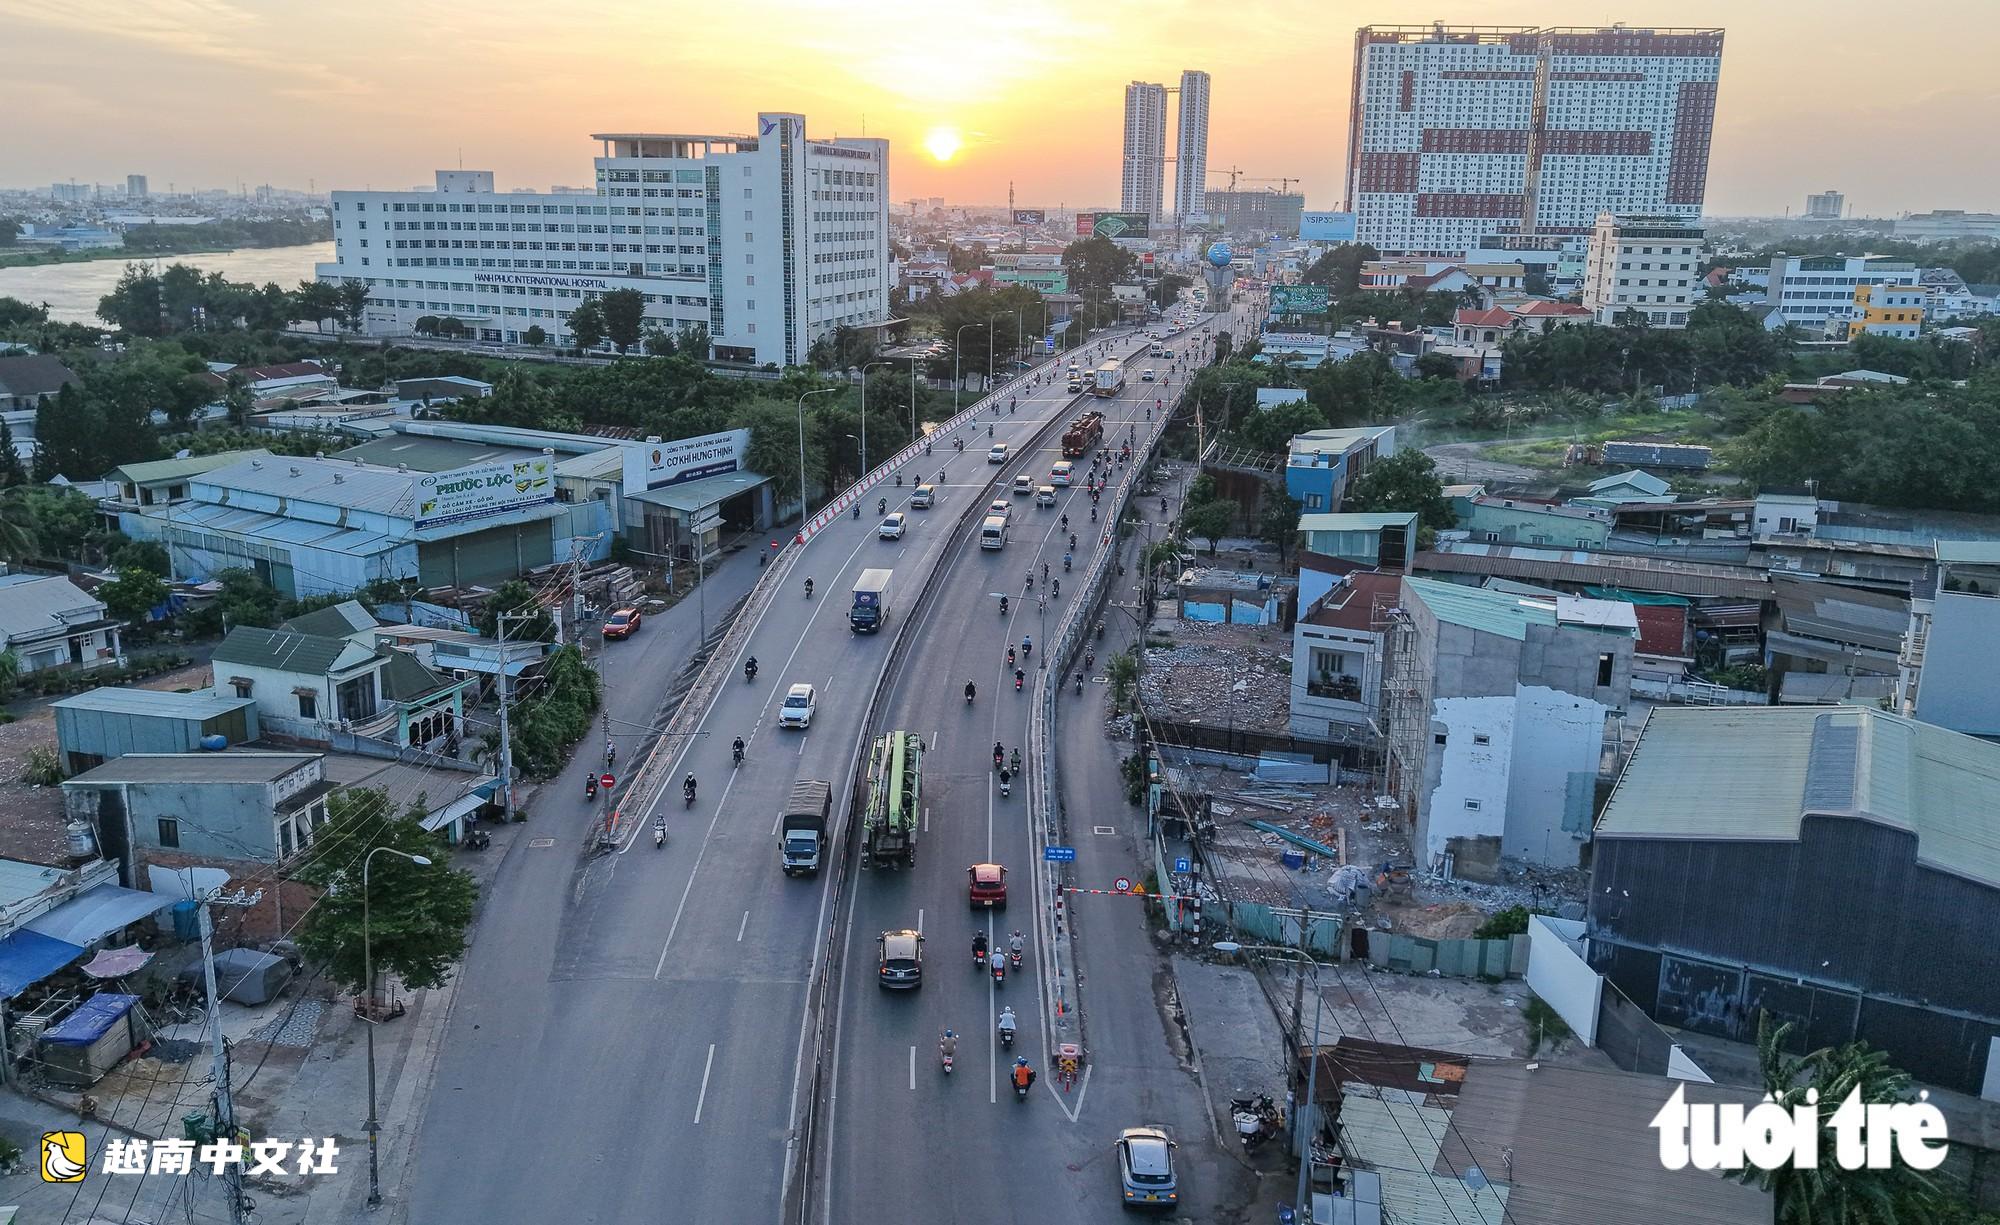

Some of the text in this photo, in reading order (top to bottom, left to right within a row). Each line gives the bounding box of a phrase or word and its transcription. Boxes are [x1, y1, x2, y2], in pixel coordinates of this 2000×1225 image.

[515, 276, 571, 287] INTERNATIONAL
[572, 278, 608, 289] HOSPITAL
[667, 446, 733, 468] CƠ KHÍ HƯNG THỊNH
[436, 473, 512, 495] PHƯỚC LỘC
